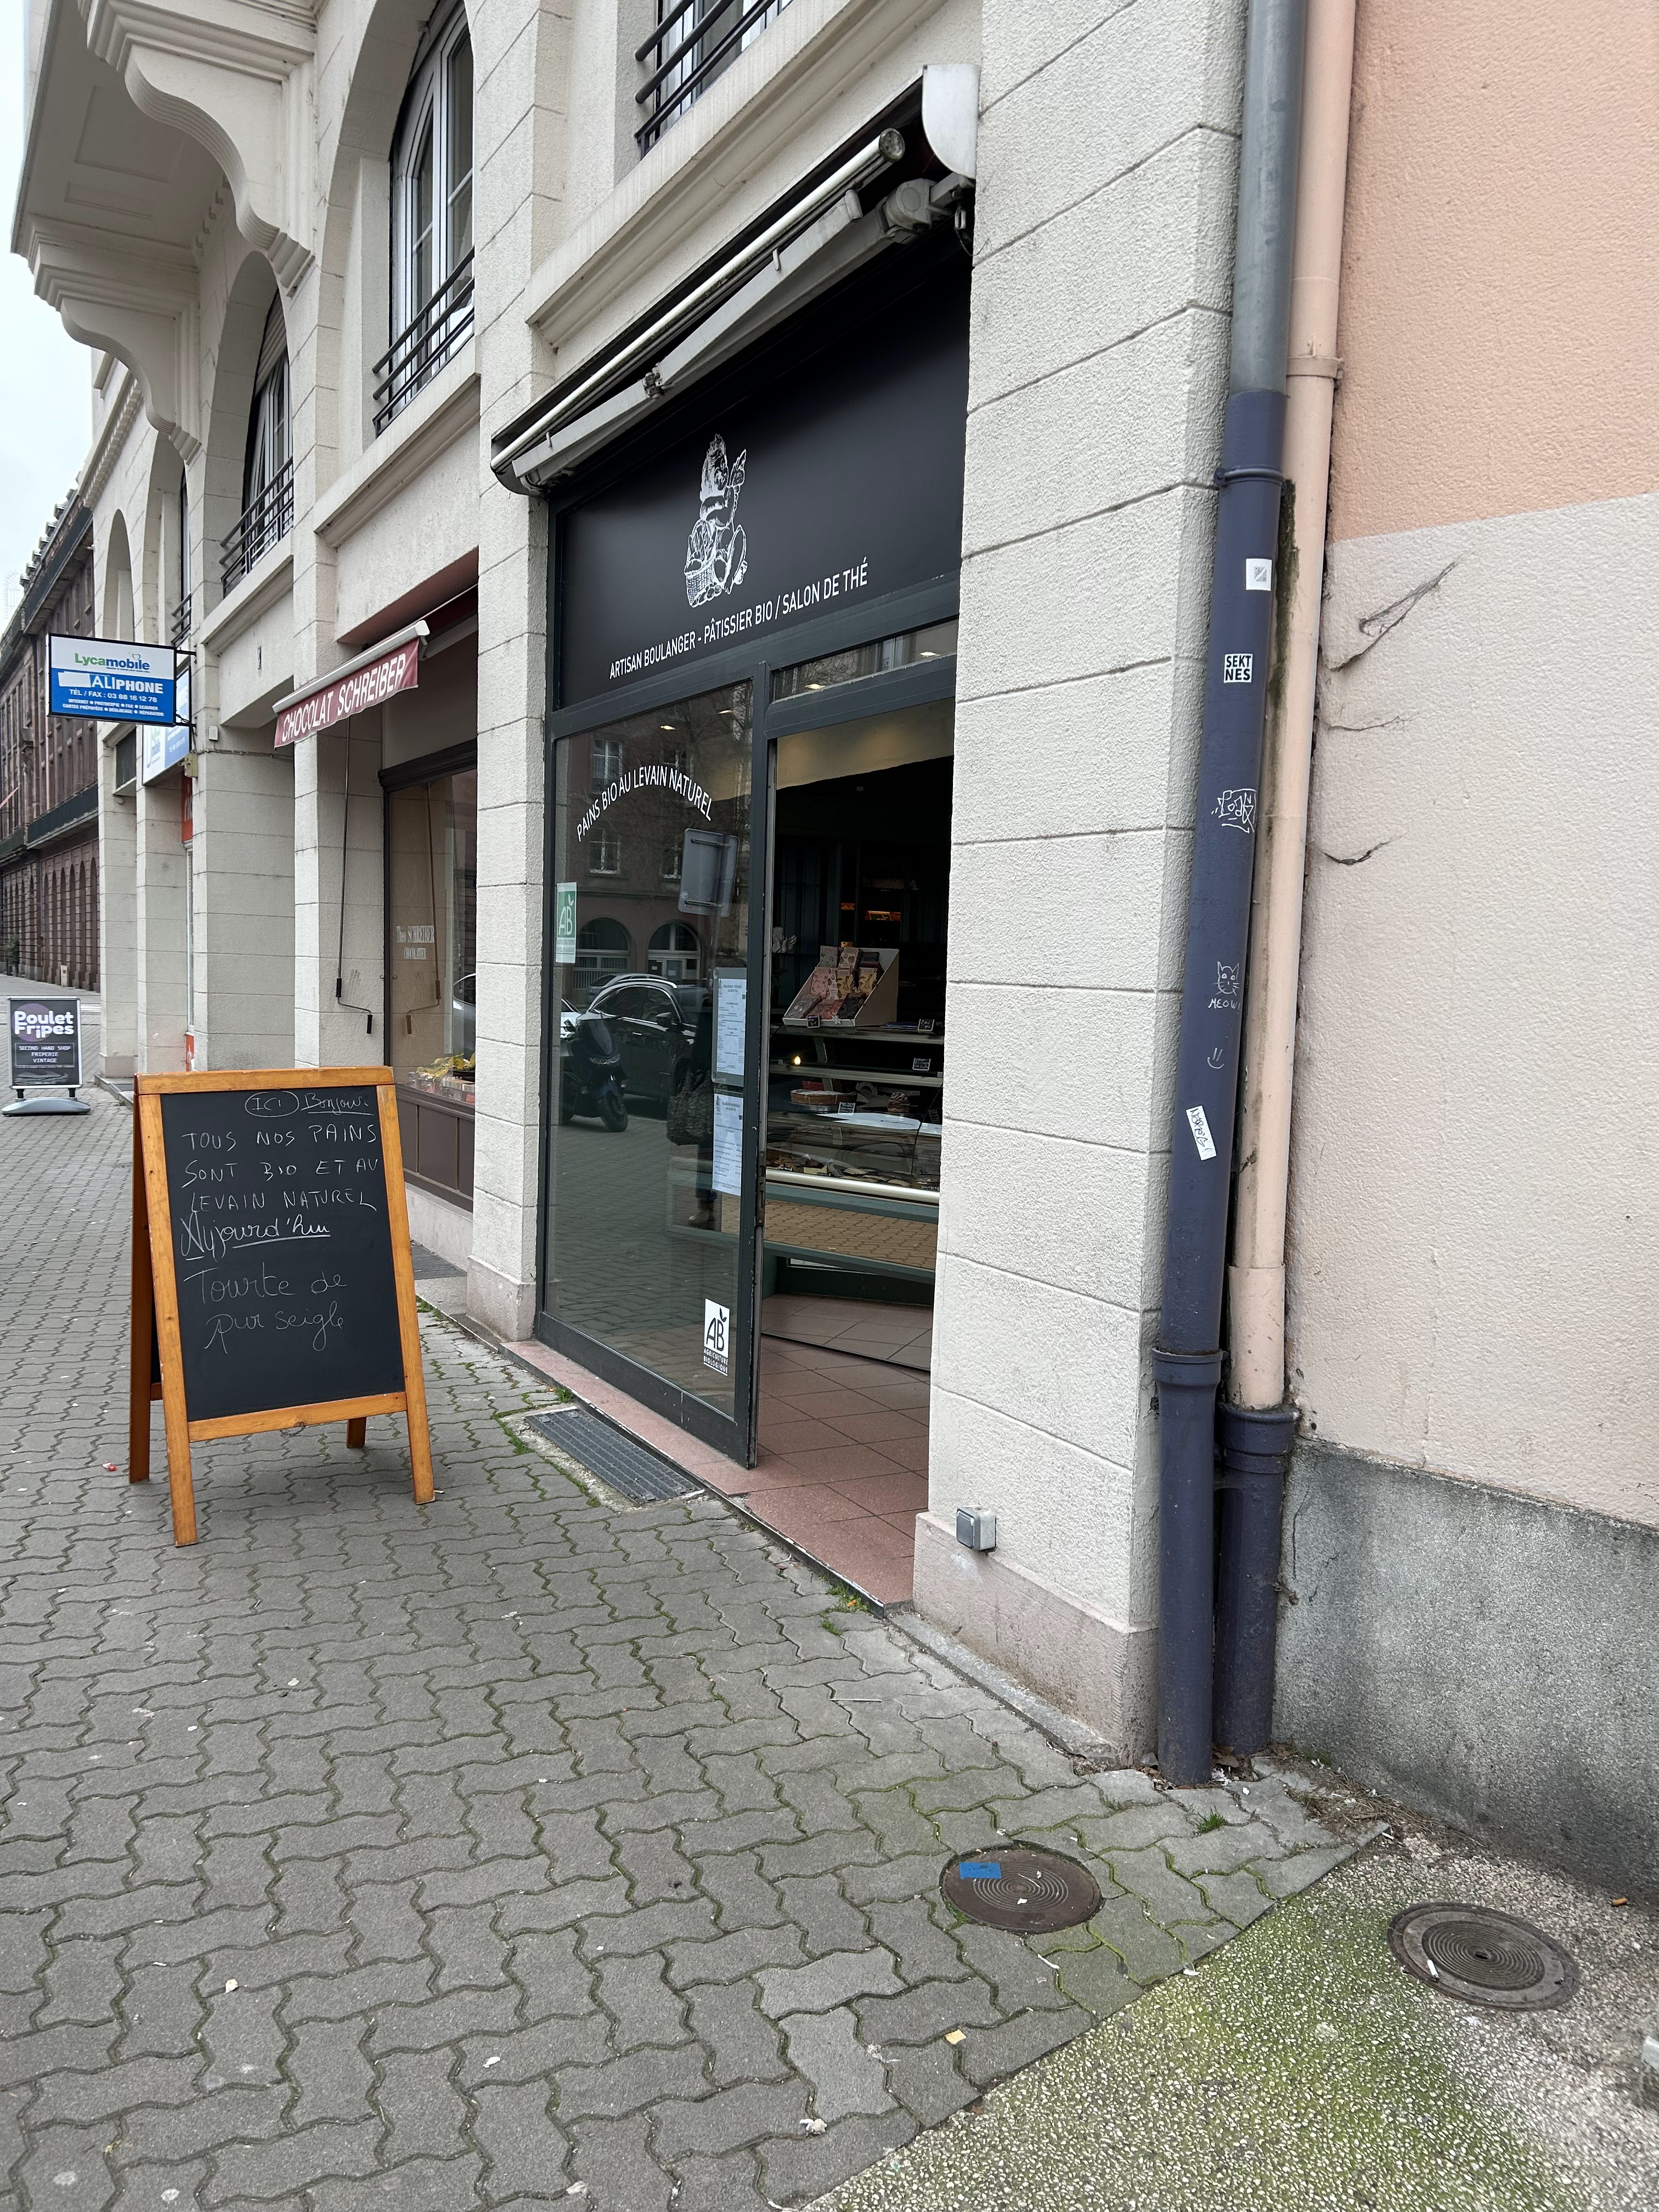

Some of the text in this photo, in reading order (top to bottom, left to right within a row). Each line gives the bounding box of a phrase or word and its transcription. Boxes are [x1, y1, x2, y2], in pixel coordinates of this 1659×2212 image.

[610, 652, 642, 680] ARTISAN
[644, 630, 696, 668] BOULANGER
[704, 608, 752, 644] PÂTISSIER
[755, 600, 772, 625] BIO
[783, 582, 820, 614] SALON
[823, 574, 839, 600] DE
[843, 557, 868, 592] THÉ
[75, 653, 150, 670] Lycamobile
[1226, 655, 1251, 668] SEKT
[92, 675, 163, 693] ALIPHONE
[1225, 668, 1250, 681] NES
[281, 653, 407, 742] CHOCOLAT SCHREIBER
[576, 765, 712, 842] PAINS BIO AU LEVAIN NATUREL
[558, 906, 573, 935] AB
[408, 926, 435, 943] SCHREIBER
[14, 1011, 74, 1025] Poulet
[14, 1023, 74, 1039] Fripes
[182, 1131, 236, 1151] TOUS
[257, 1131, 295, 1146] NOS
[182, 1160, 238, 1188] SONT
[260, 1162, 296, 1182] BIO
[316, 1160, 346, 1175] ET
[191, 1188, 377, 1212] LEVAIN NATUREL
[183, 1262, 347, 1305] Tourte de
[275, 1301, 343, 1351] seigle
[706, 1318, 725, 1351] AB
[703, 1348, 728, 1365] AGRICULTURE
[703, 1355, 728, 1373] BIOLOGIQUE
